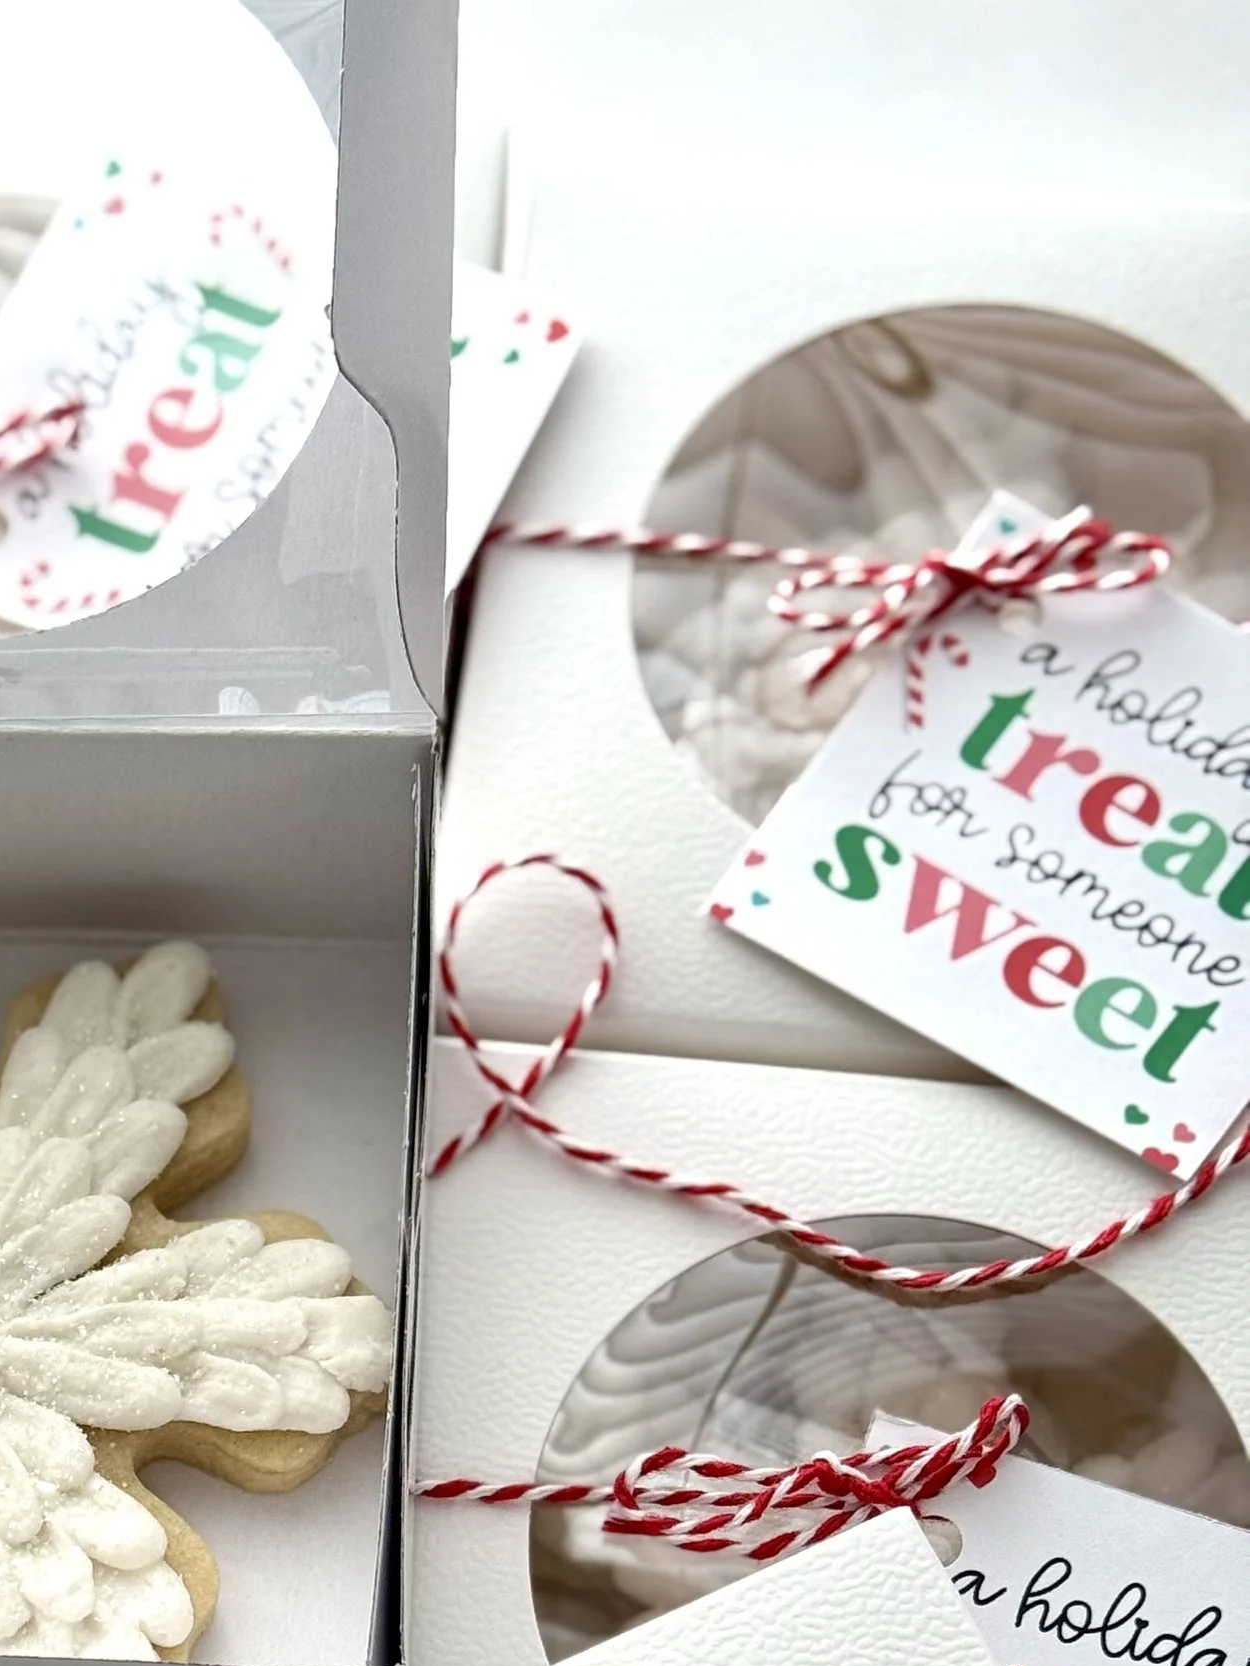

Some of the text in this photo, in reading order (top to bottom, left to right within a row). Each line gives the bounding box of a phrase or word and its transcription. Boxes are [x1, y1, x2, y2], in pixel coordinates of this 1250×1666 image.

[66, 277, 284, 556] treat
[1020, 642, 1250, 845] a holida
[813, 824, 1221, 1084] sweet
[868, 749, 1246, 988] for someone
[951, 1569, 1008, 1606] a
